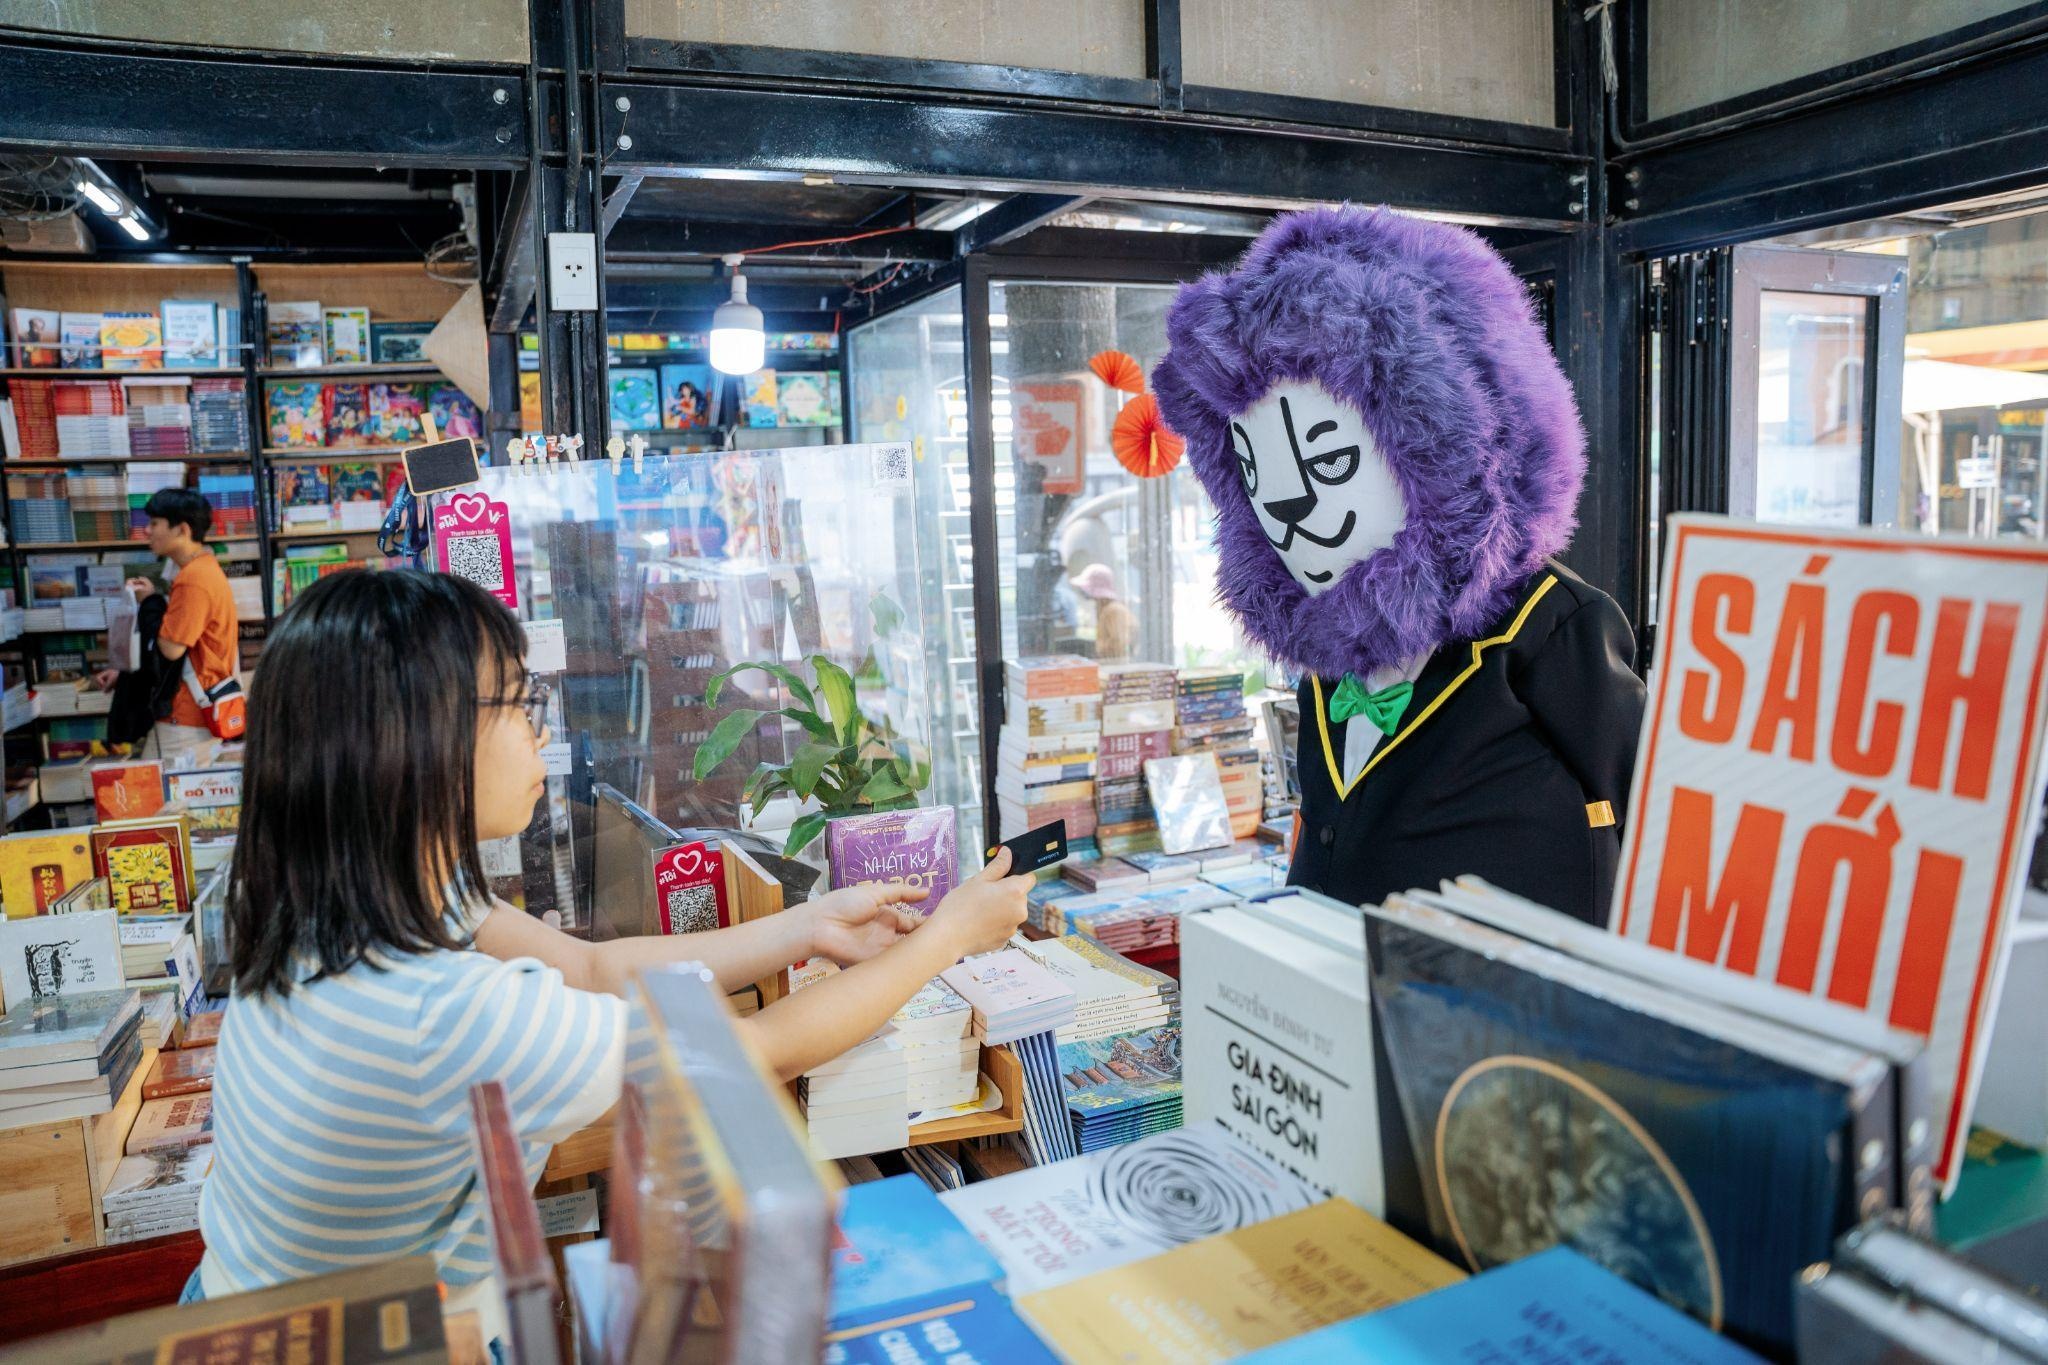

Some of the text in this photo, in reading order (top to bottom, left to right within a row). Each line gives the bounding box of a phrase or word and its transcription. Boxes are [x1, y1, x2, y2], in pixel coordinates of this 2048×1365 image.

[438, 513, 459, 530] #Tôi
[1679, 555, 2021, 800] SÁCH
[658, 868, 677, 885] #Tôi
[864, 846, 928, 875] NHẬT KÝ
[1649, 787, 1964, 1035] MỚI
[1227, 1041, 1322, 1120] GIA ĐỊNH
[1024, 1199, 1092, 1257] TRONG
